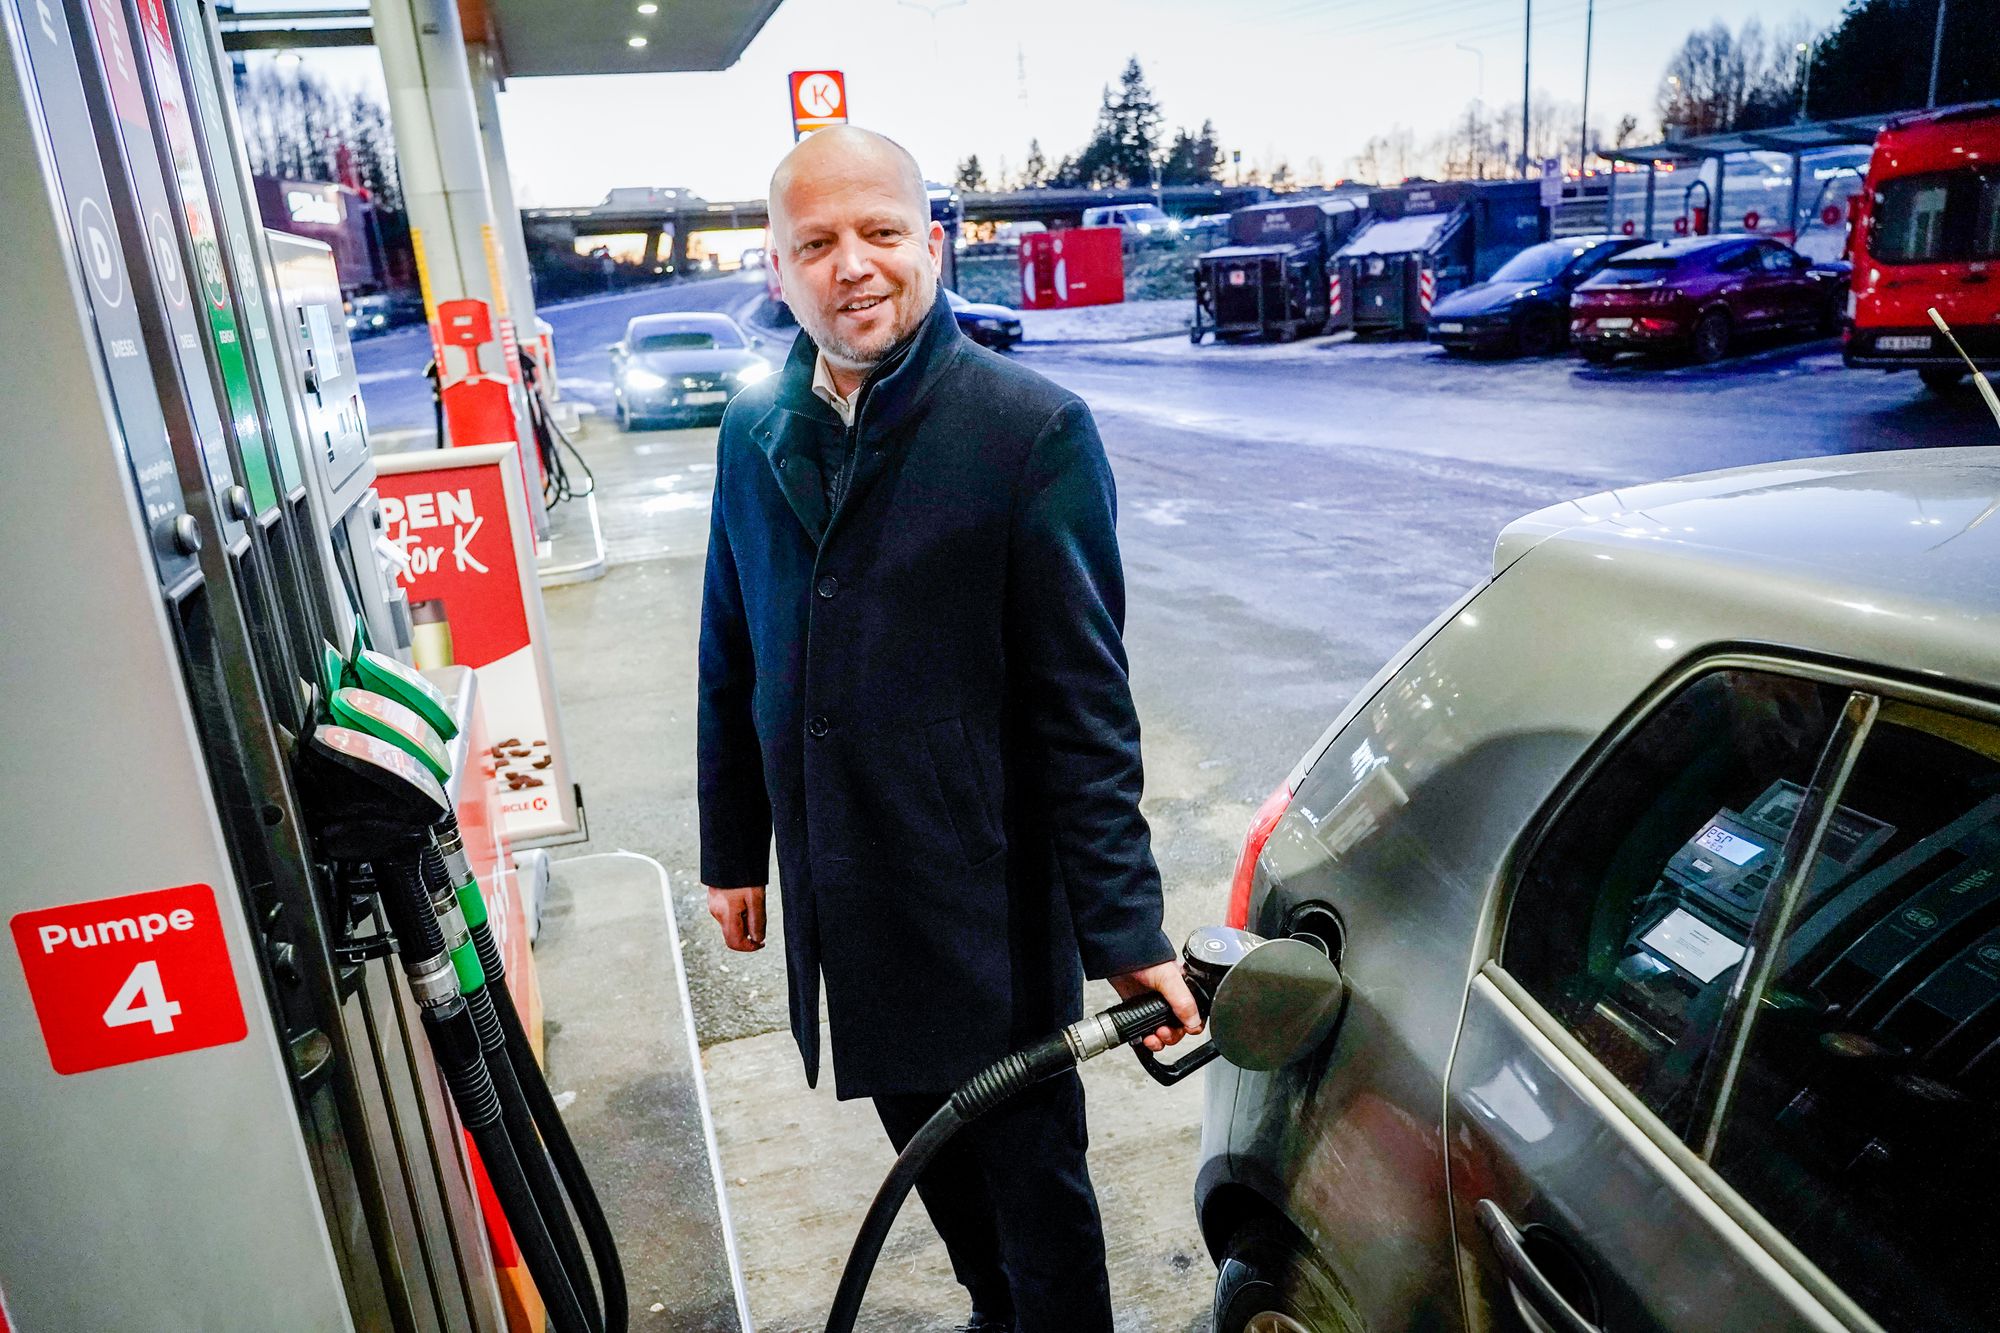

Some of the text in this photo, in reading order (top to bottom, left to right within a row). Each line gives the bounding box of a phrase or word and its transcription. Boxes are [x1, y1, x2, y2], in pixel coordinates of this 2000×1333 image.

[1545, 159, 1558, 176] P
[88, 226, 112, 280] D
[158, 237, 176, 282] D
[202, 242, 220, 284] 98
[238, 253, 255, 288] 95
[111, 339, 139, 358] DIESEL
[379, 488, 476, 532] PEN
[452, 516, 489, 573] K
[534, 797, 548, 811] K
[38, 908, 195, 954] Pumpe
[102, 960, 182, 1035] 4
